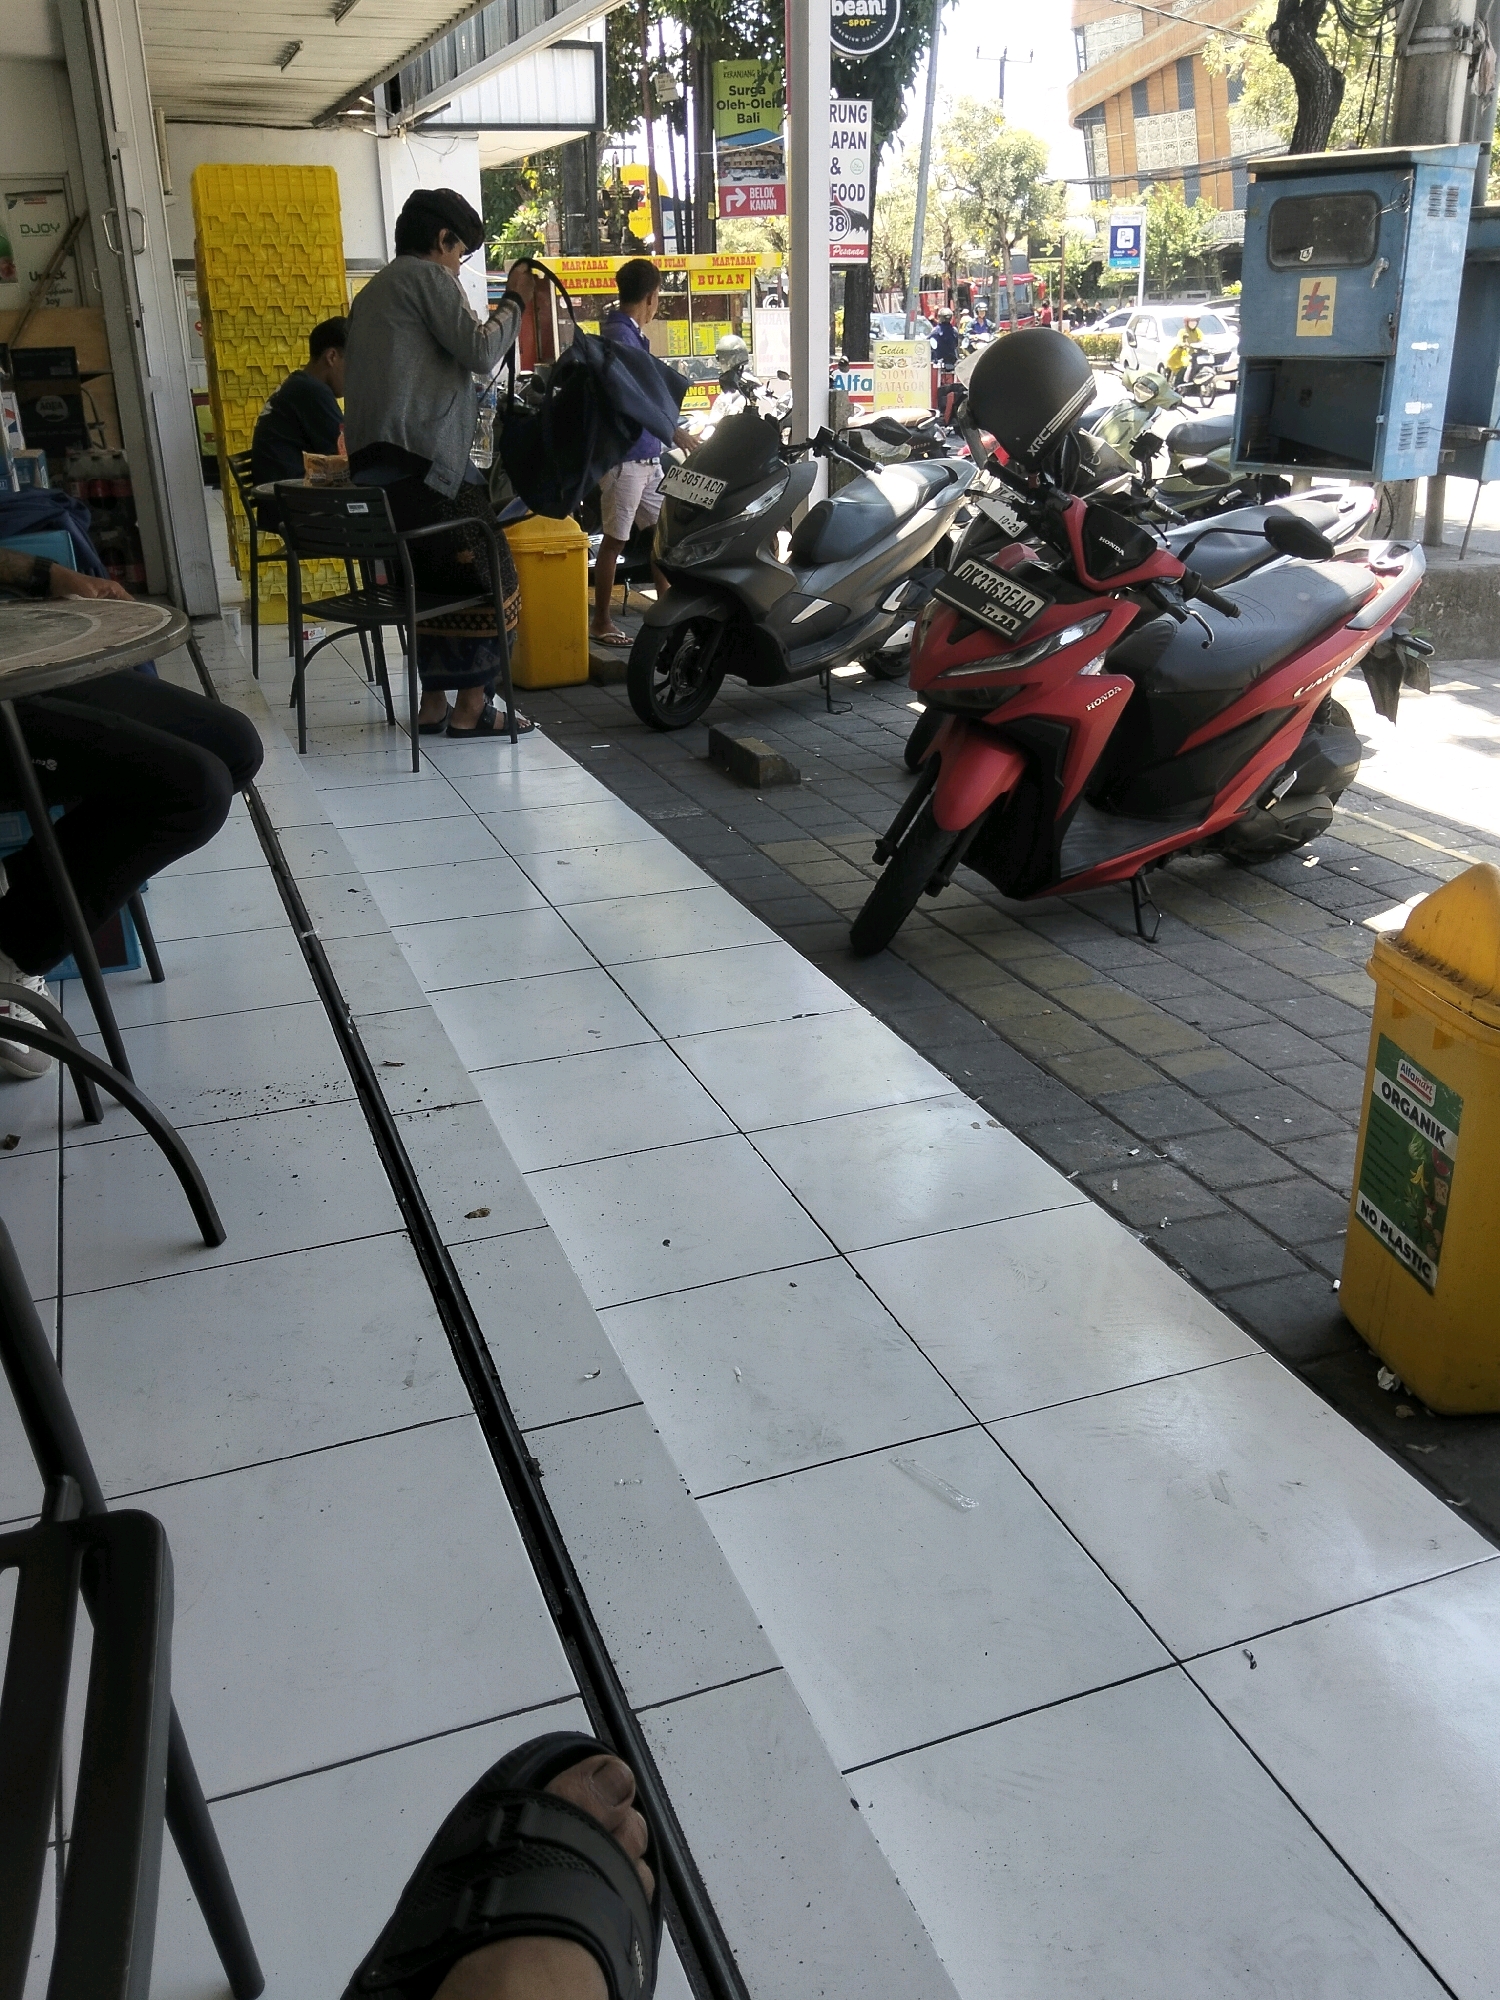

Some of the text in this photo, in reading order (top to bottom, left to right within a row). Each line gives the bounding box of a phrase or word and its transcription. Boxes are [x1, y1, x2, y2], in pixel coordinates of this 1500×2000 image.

[832, 0, 887, 16] bean!
[862, 24, 884, 42] QUALITY
[729, 85, 766, 97] Surga
[737, 113, 760, 124] Bali
[829, 104, 868, 124] RUNG
[831, 131, 867, 150] APAN
[830, 157, 841, 175] &
[750, 187, 775, 199] BELOK
[750, 199, 777, 211] KANAN
[20, 222, 60, 234] DJOY
[562, 260, 608, 271] MARTABAK
[712, 256, 757, 267] MARTABAK
[560, 278, 616, 290] MARTABAK
[697, 273, 745, 286] BULAN
[879, 345, 909, 355] Sedia:
[881, 370, 920, 380] SIOMAY
[833, 374, 873, 391] Alfa
[876, 381, 925, 392] BATAGOR
[896, 393, 904, 403] &
[1079, 463, 1097, 478] ONDA
[682, 471, 706, 488] 5051
[1099, 536, 1126, 557] HONDA
[1085, 685, 1123, 712] HONDA
[1400, 1062, 1434, 1097] Alfamart
[1381, 1081, 1447, 1148] ORGANIK
[1360, 1199, 1433, 1279] NO PLASTIC
